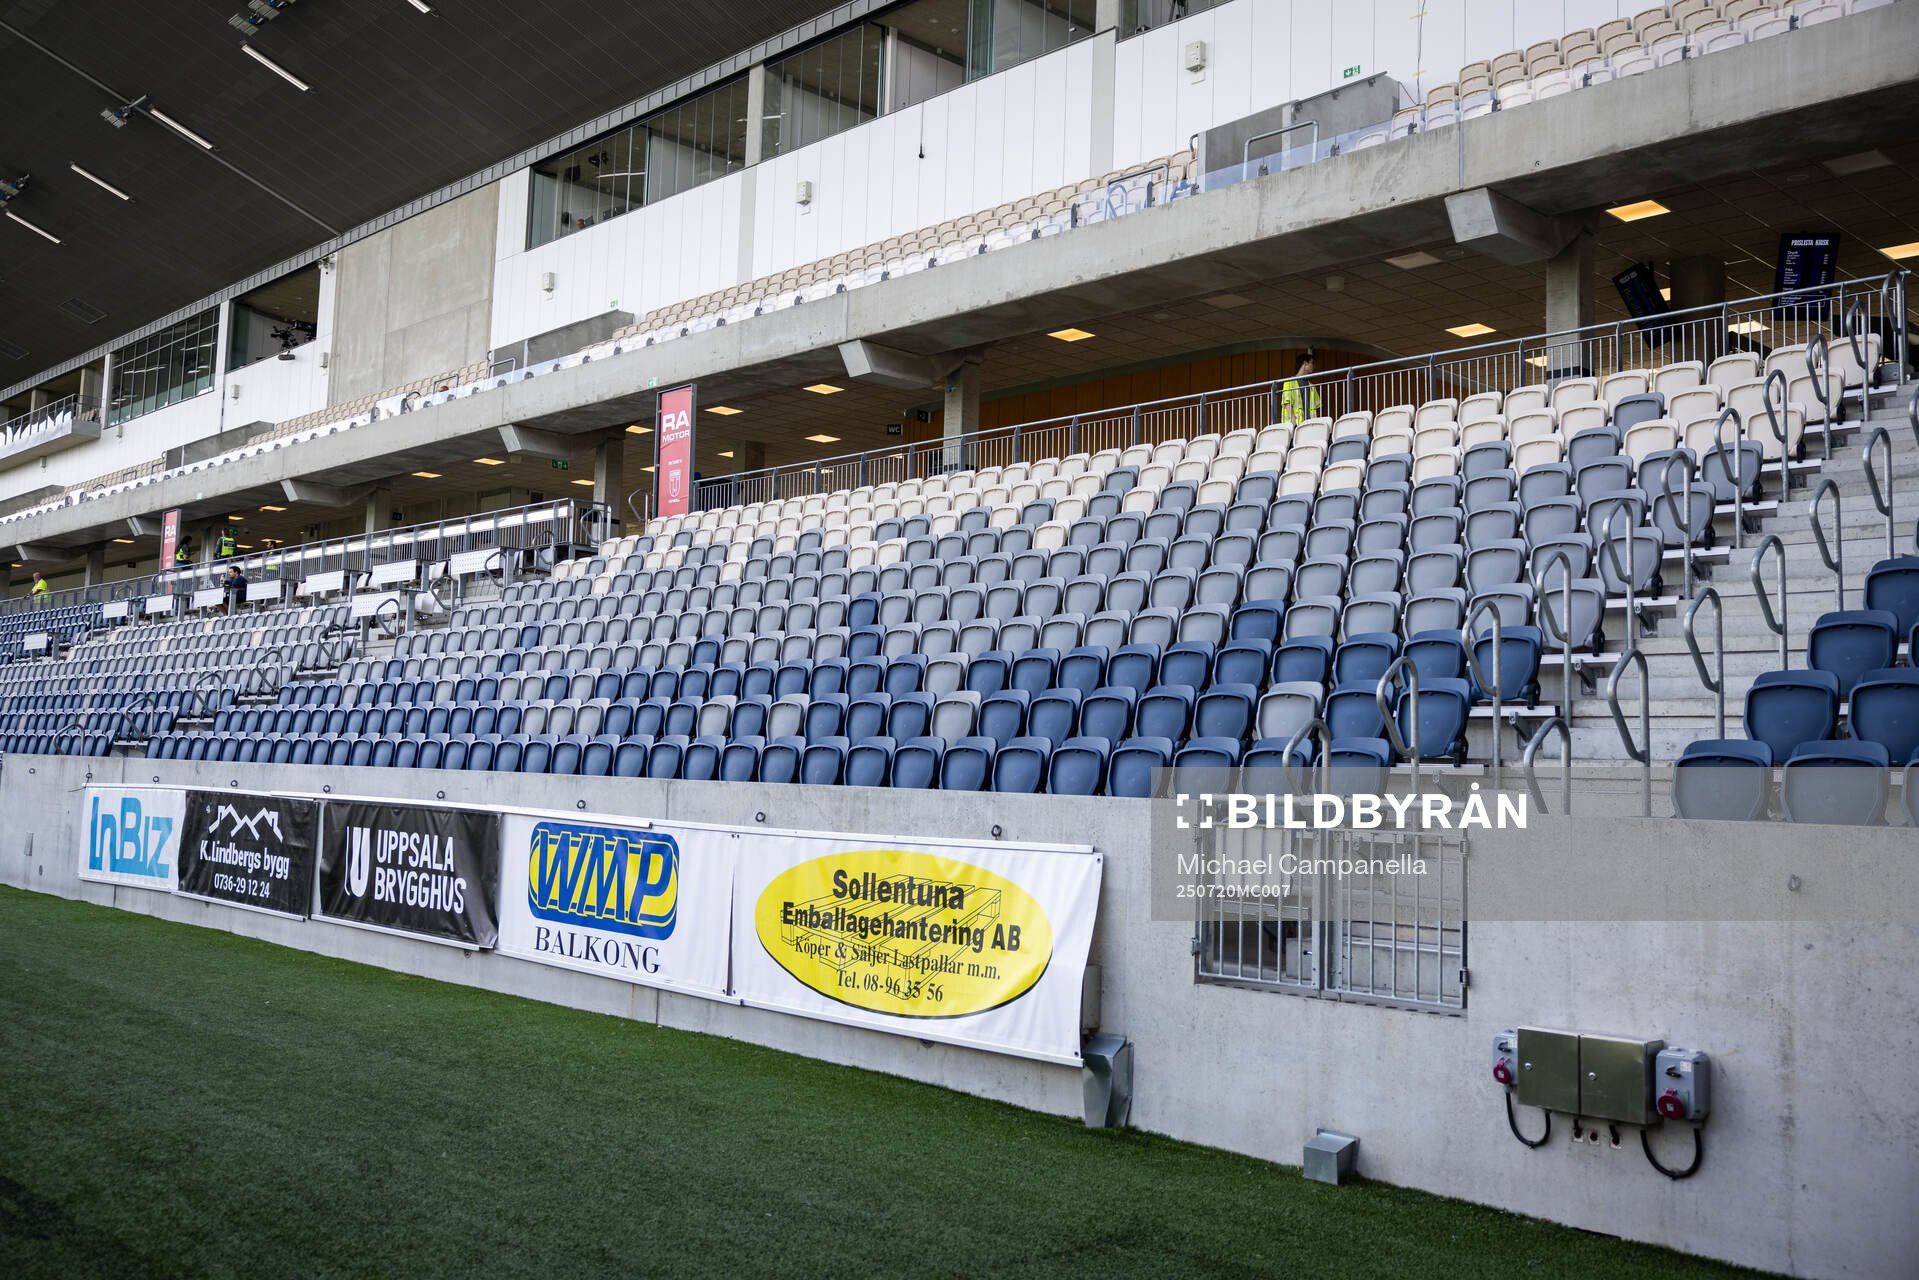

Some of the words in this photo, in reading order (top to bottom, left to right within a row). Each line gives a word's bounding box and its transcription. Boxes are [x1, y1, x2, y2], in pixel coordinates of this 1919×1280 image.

[662, 410, 690, 432] RA
[662, 429, 690, 443] MOTOR
[164, 525, 176, 538] RA
[263, 847, 290, 880] bygg
[376, 829, 455, 873] UPPSALA
[214, 872, 246, 892] 0736-29
[248, 879, 259, 896] 12
[259, 881, 271, 898] 24
[374, 866, 467, 915] BRYGGHUS
[536, 828, 674, 926] WMP
[833, 869, 965, 910] Sollentuna
[783, 901, 985, 954] Emballagehantering
[991, 923, 1021, 951] AB
[534, 926, 661, 974] BALKONG
[795, 936, 831, 959] Köper
[834, 941, 847, 959] &
[851, 943, 890, 967] Säljer
[893, 948, 964, 975] Lastpallar
[967, 960, 1001, 980] m.m.
[837, 968, 860, 990] Tel.
[904, 979, 921, 998] 35
[926, 982, 944, 1002] 56
